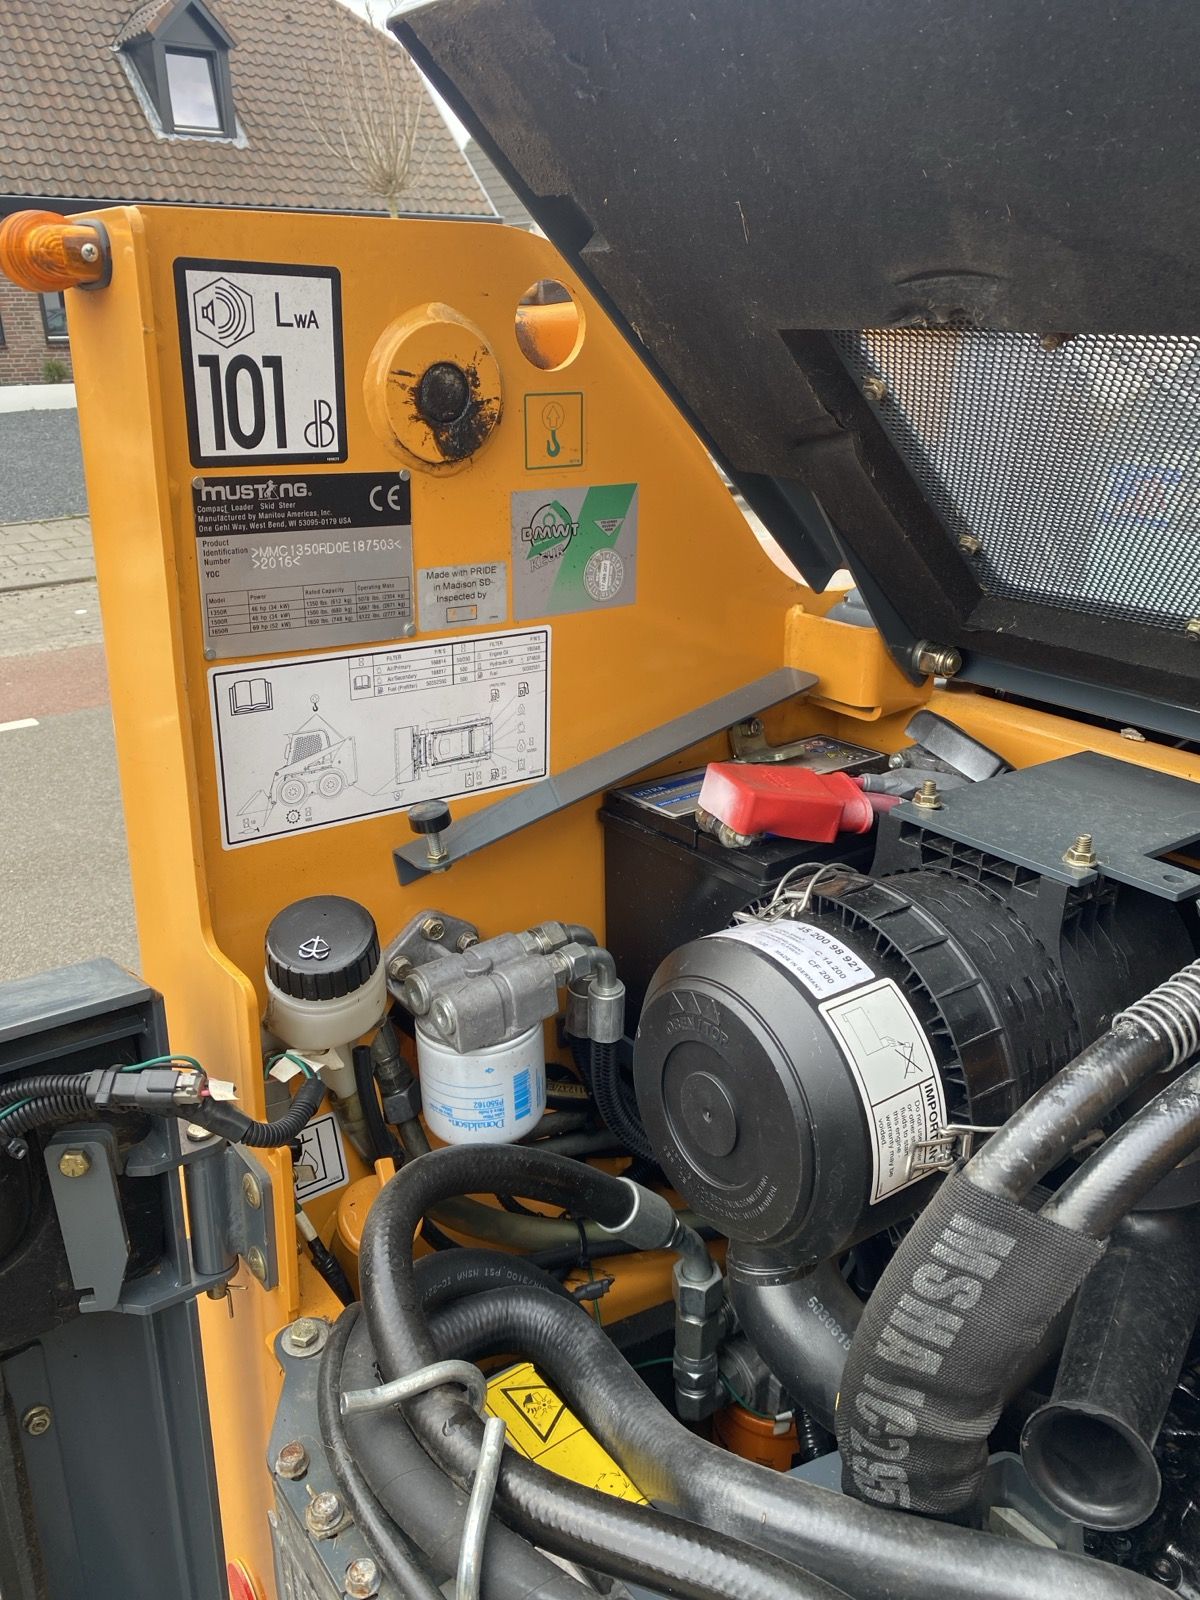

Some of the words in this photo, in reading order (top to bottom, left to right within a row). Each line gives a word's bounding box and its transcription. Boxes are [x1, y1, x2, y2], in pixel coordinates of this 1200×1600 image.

[198, 354, 287, 451] 101
[304, 400, 335, 448] dB
[369, 485, 401, 512] CE
[197, 504, 228, 514] Compact
[231, 503, 254, 511] Loader
[260, 502, 276, 510] Skid
[278, 501, 296, 509] Steer
[198, 513, 246, 523] Manufactured
[248, 513, 256, 521] by
[258, 511, 285, 520] Manitou
[199, 524, 213, 532] One
[215, 523, 231, 531] Gehl
[249, 521, 266, 529] West
[268, 520, 287, 529] Bend,
[299, 518, 337, 527] 53095-0179
[338, 517, 352, 525] USA
[520, 522, 579, 542] BMWT
[202, 539, 229, 547] Product
[203, 546, 248, 556] Identification
[204, 557, 231, 566] Number
[426, 570, 449, 580] Made
[451, 568, 467, 578] with
[470, 565, 497, 575] PRIDE
[433, 582, 441, 590] in
[442, 579, 477, 590] Madison
[208, 596, 226, 604] Model
[321, 587, 345, 595] Capacity
[357, 584, 381, 592] Operating
[268, 603, 278, 611] (34
[280, 602, 290, 611] kW)
[343, 597, 352, 605] kg)
[396, 592, 406, 600] kg)
[436, 591, 475, 603] Inspected
[477, 591, 487, 601] by
[260, 614, 268, 622] hp
[280, 612, 291, 620] kW)
[343, 606, 353, 614] kg)
[260, 623, 268, 631] hp
[281, 621, 291, 629] kW)
[634, 785, 665, 798] ULTRA
[810, 930, 831, 945] 200
[829, 943, 845, 955] 98
[842, 954, 863, 973] 921
[796, 966, 823, 992] GERMANY
[807, 959, 820, 971] CF
[819, 970, 834, 985] 200
[907, 1104, 913, 1112] or
[914, 1099, 921, 1112] Do
[451, 1119, 505, 1132] Donaldson
[899, 1106, 907, 1129] fluids
[903, 1129, 908, 1138] to
[924, 1083, 939, 1163] IMPORTAN
[885, 1114, 894, 1149] warranty
[894, 1127, 902, 1155] engine
[888, 1167, 894, 1178] be
[484, 1268, 501, 1277] PSI
[877, 1213, 1017, 1375] MSHA
